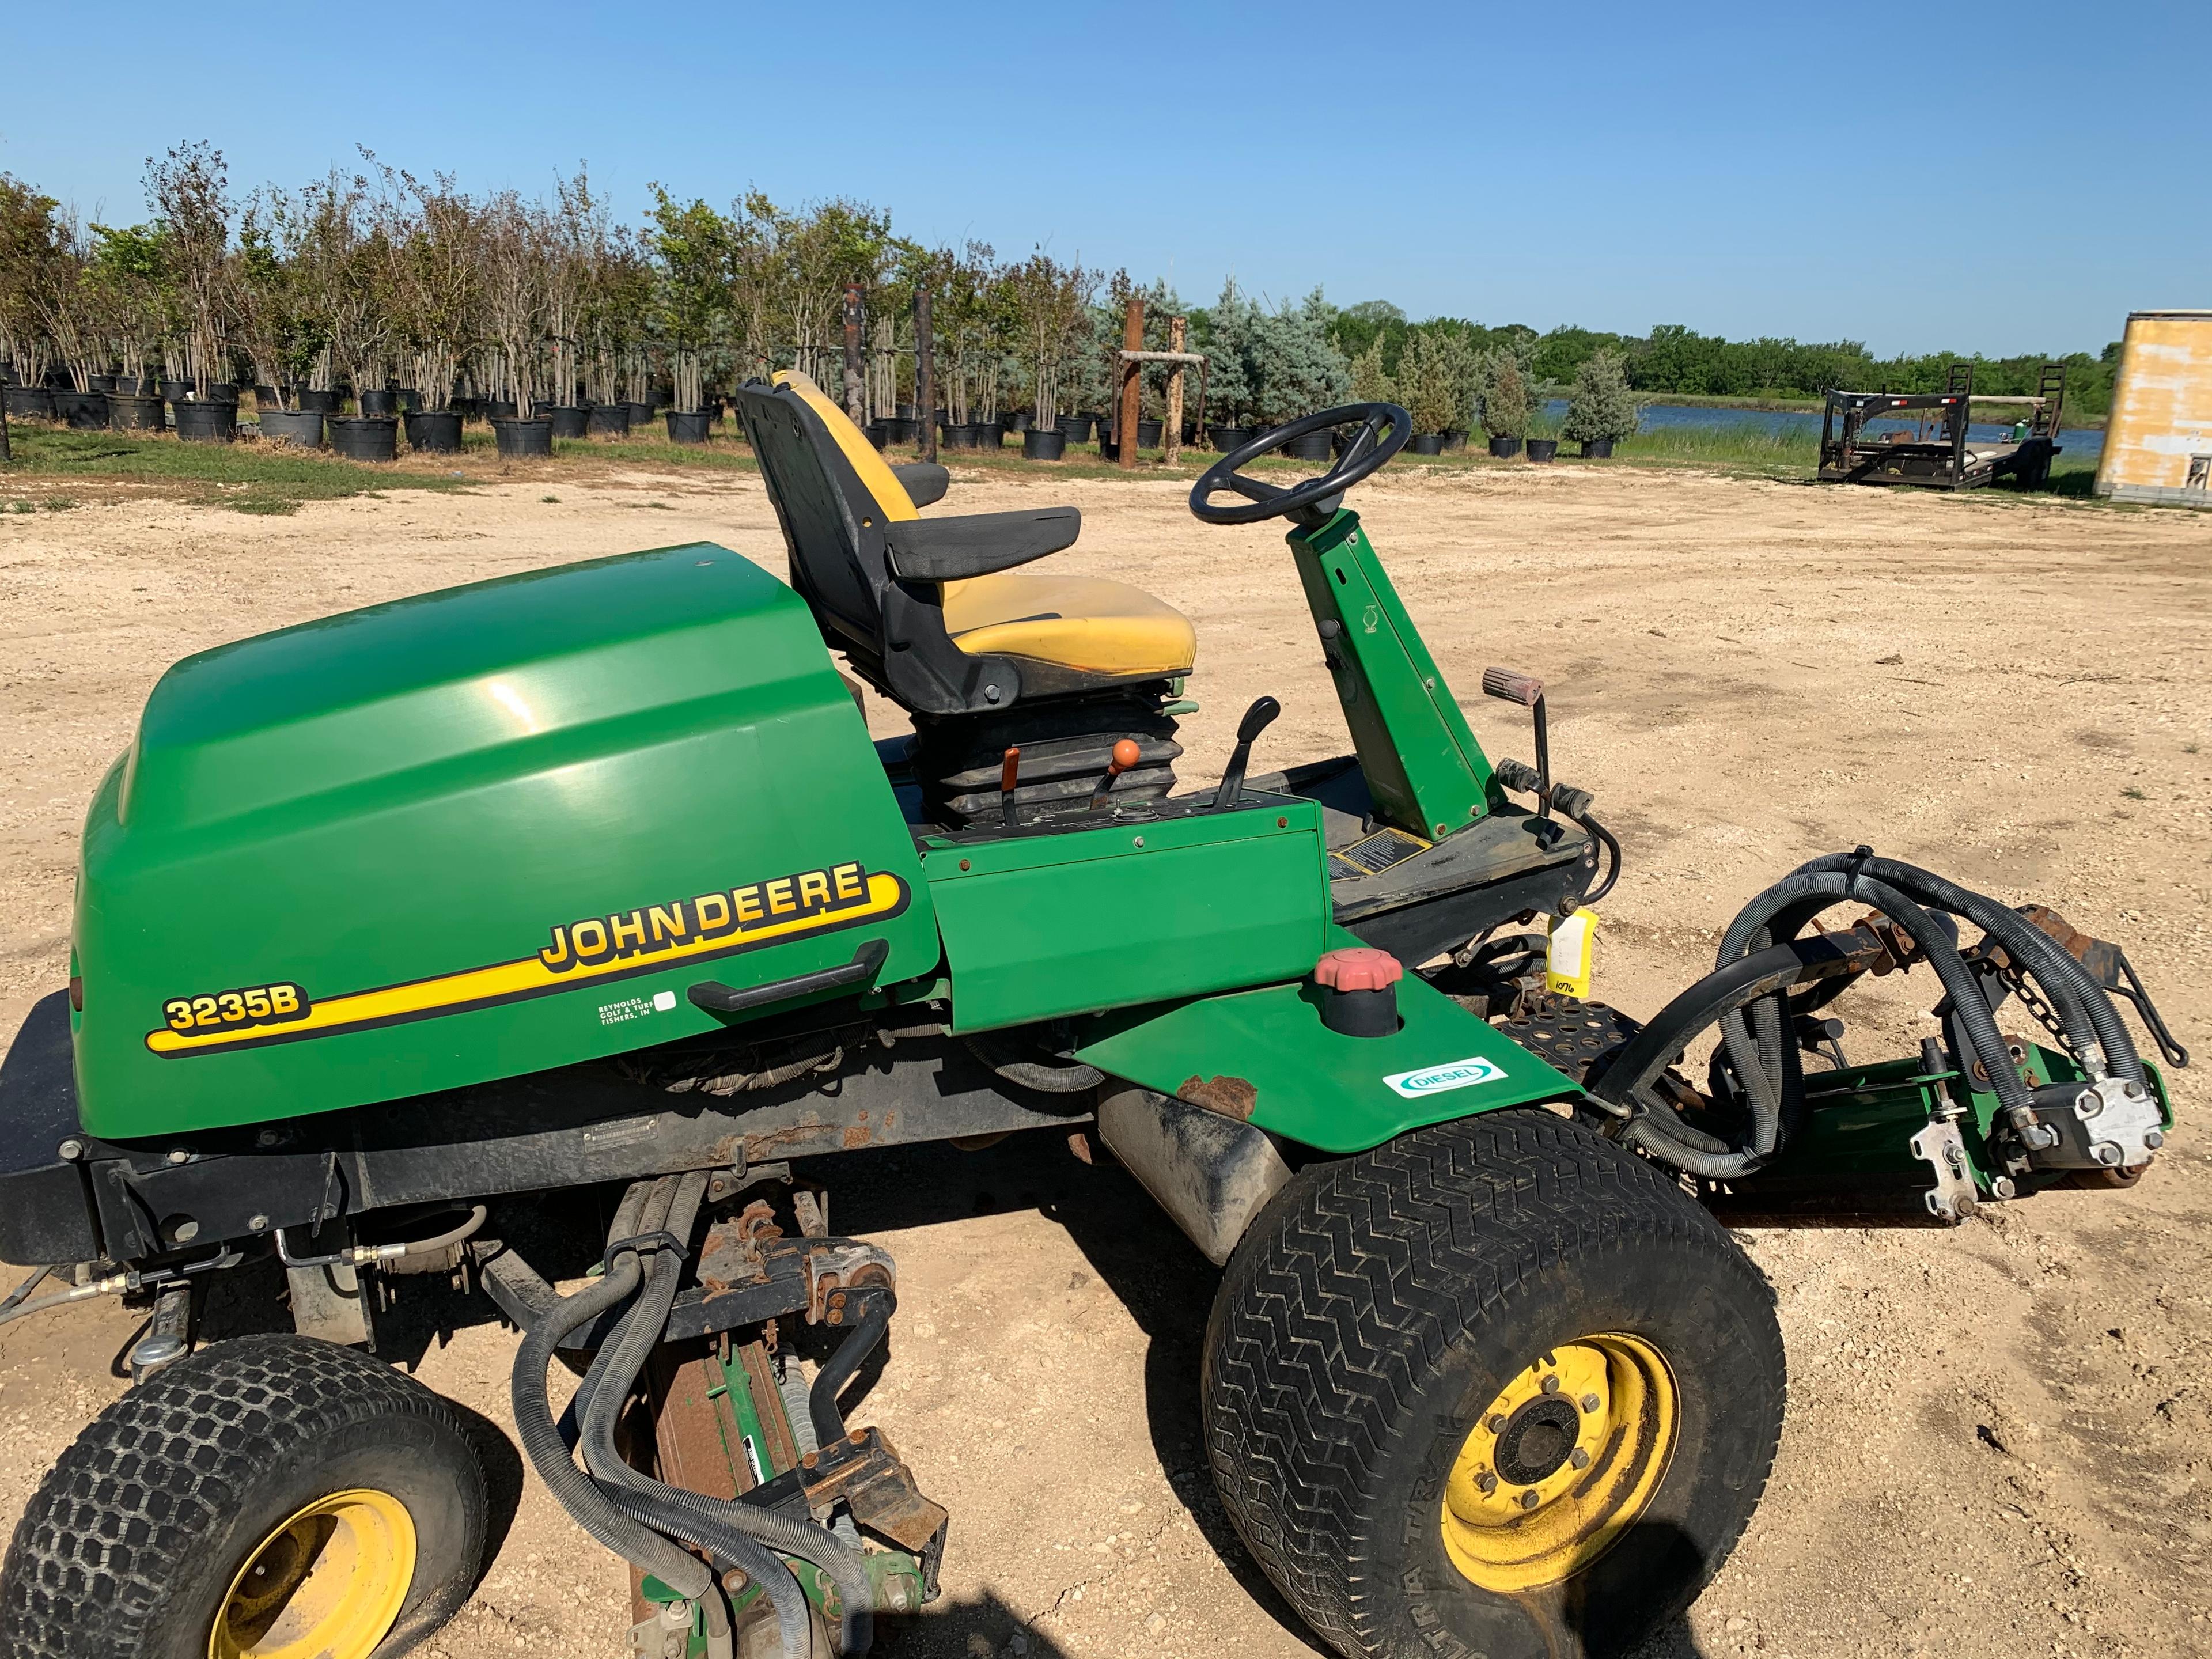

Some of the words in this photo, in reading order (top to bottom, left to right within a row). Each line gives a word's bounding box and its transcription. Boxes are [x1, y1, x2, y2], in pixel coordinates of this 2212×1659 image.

[542, 903, 686, 964] JOHN
[695, 863, 863, 931] DEERE
[1556, 980, 1575, 993] 1076
[166, 985, 299, 1029] 3235B
[599, 997, 641, 1013] REYNOLDS
[600, 1009, 621, 1019] GOLF
[633, 1001, 653, 1011] TURF
[601, 1012, 637, 1025] FISHERS,
[1413, 1069, 1479, 1087] DIESEL
